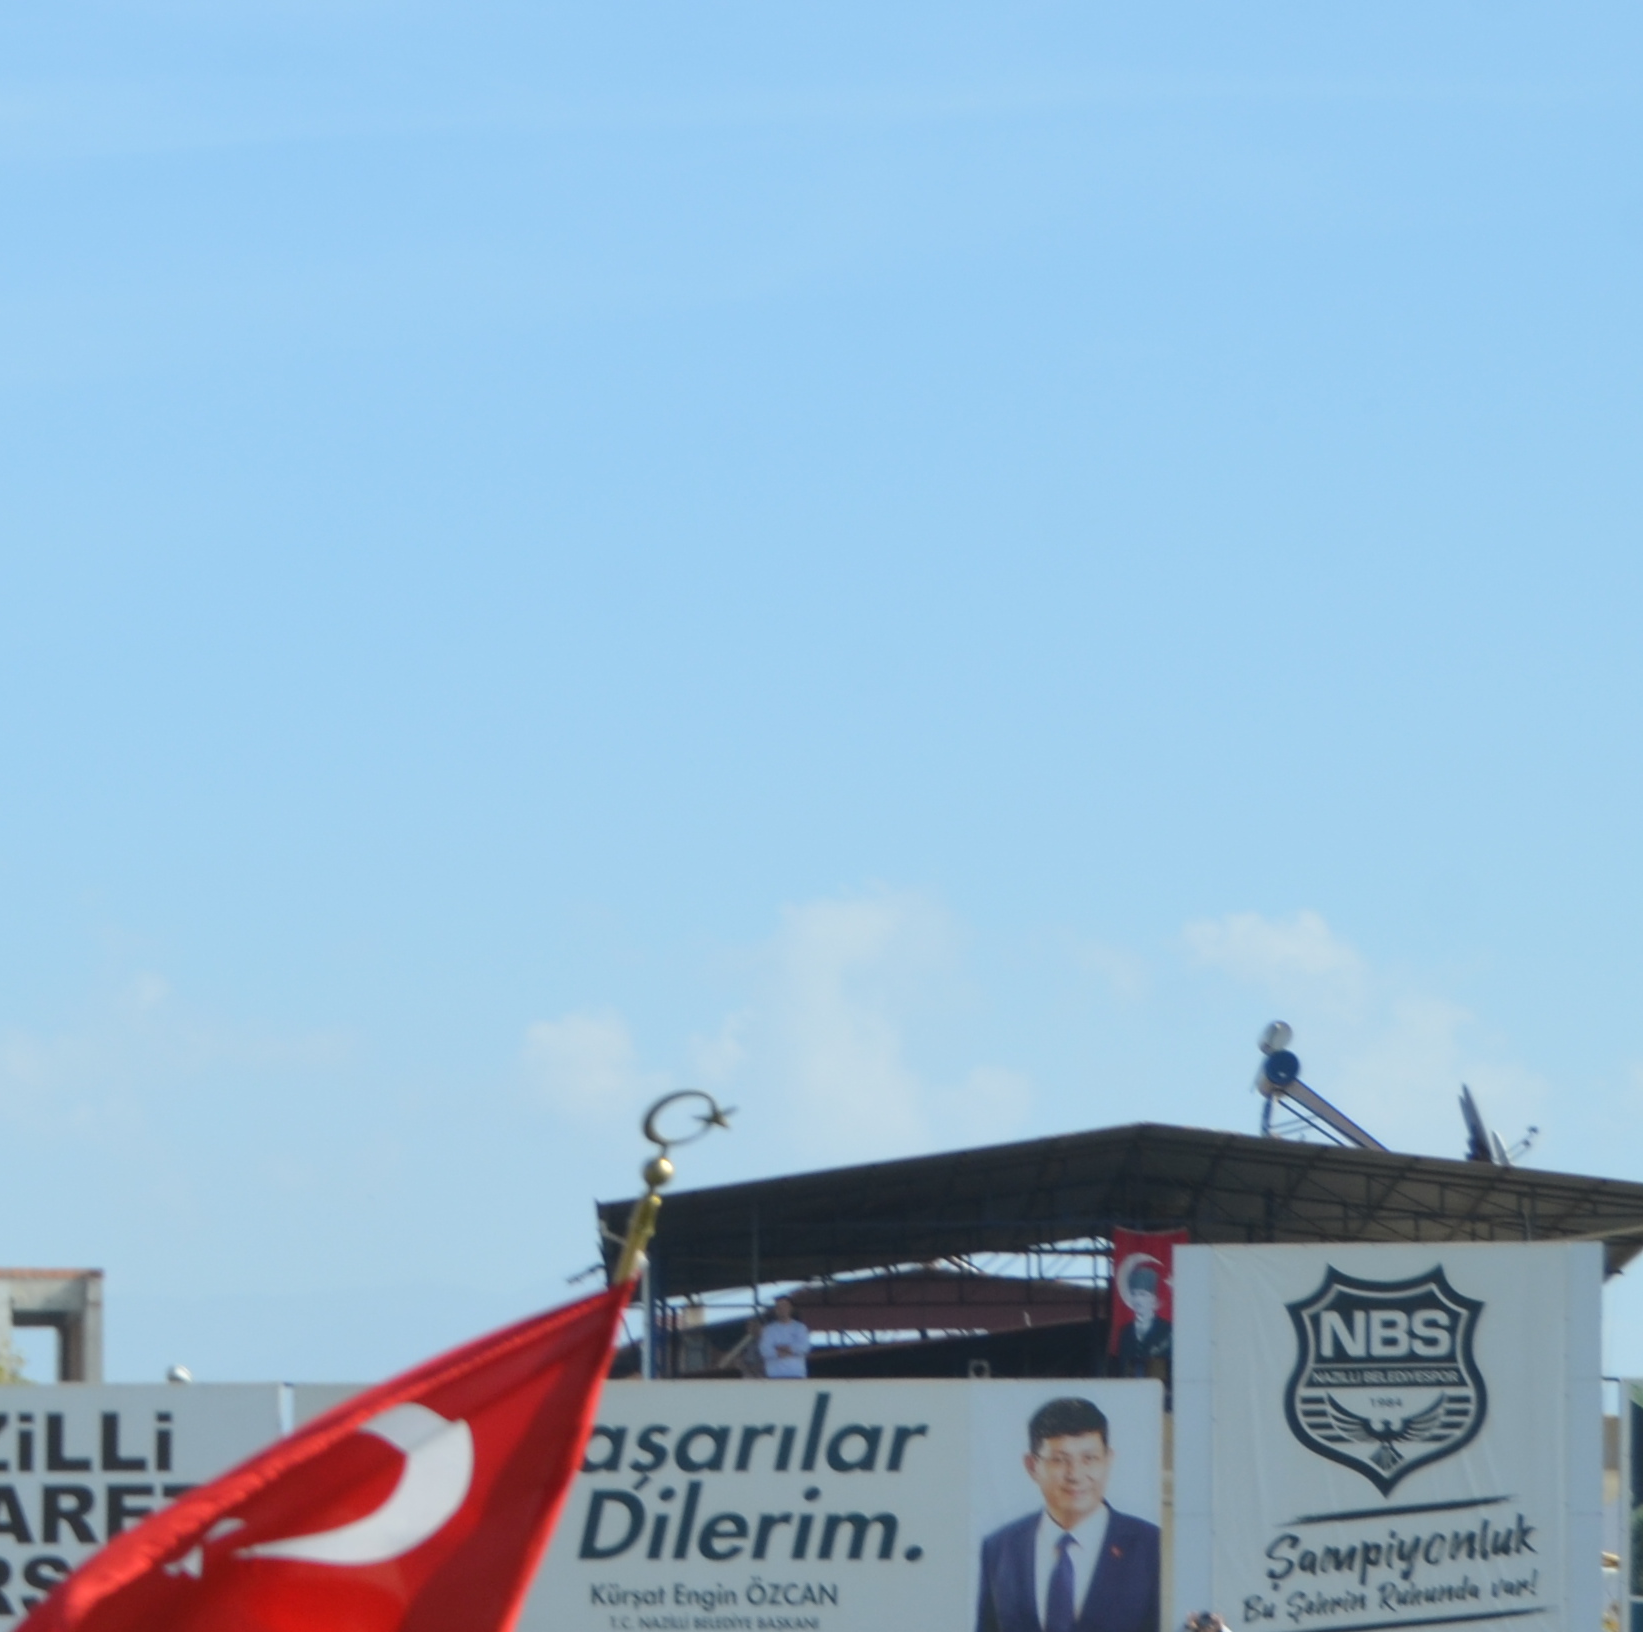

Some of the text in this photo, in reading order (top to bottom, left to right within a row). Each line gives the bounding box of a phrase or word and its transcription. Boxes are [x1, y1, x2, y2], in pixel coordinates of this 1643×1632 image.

[1319, 1308, 1452, 1358] NBS
[576, 1390, 930, 1491] aşarılar
[578, 1479, 924, 1563] Dilerim.
[590, 1574, 839, 1612] Kürşat Engin ÖZCAN
